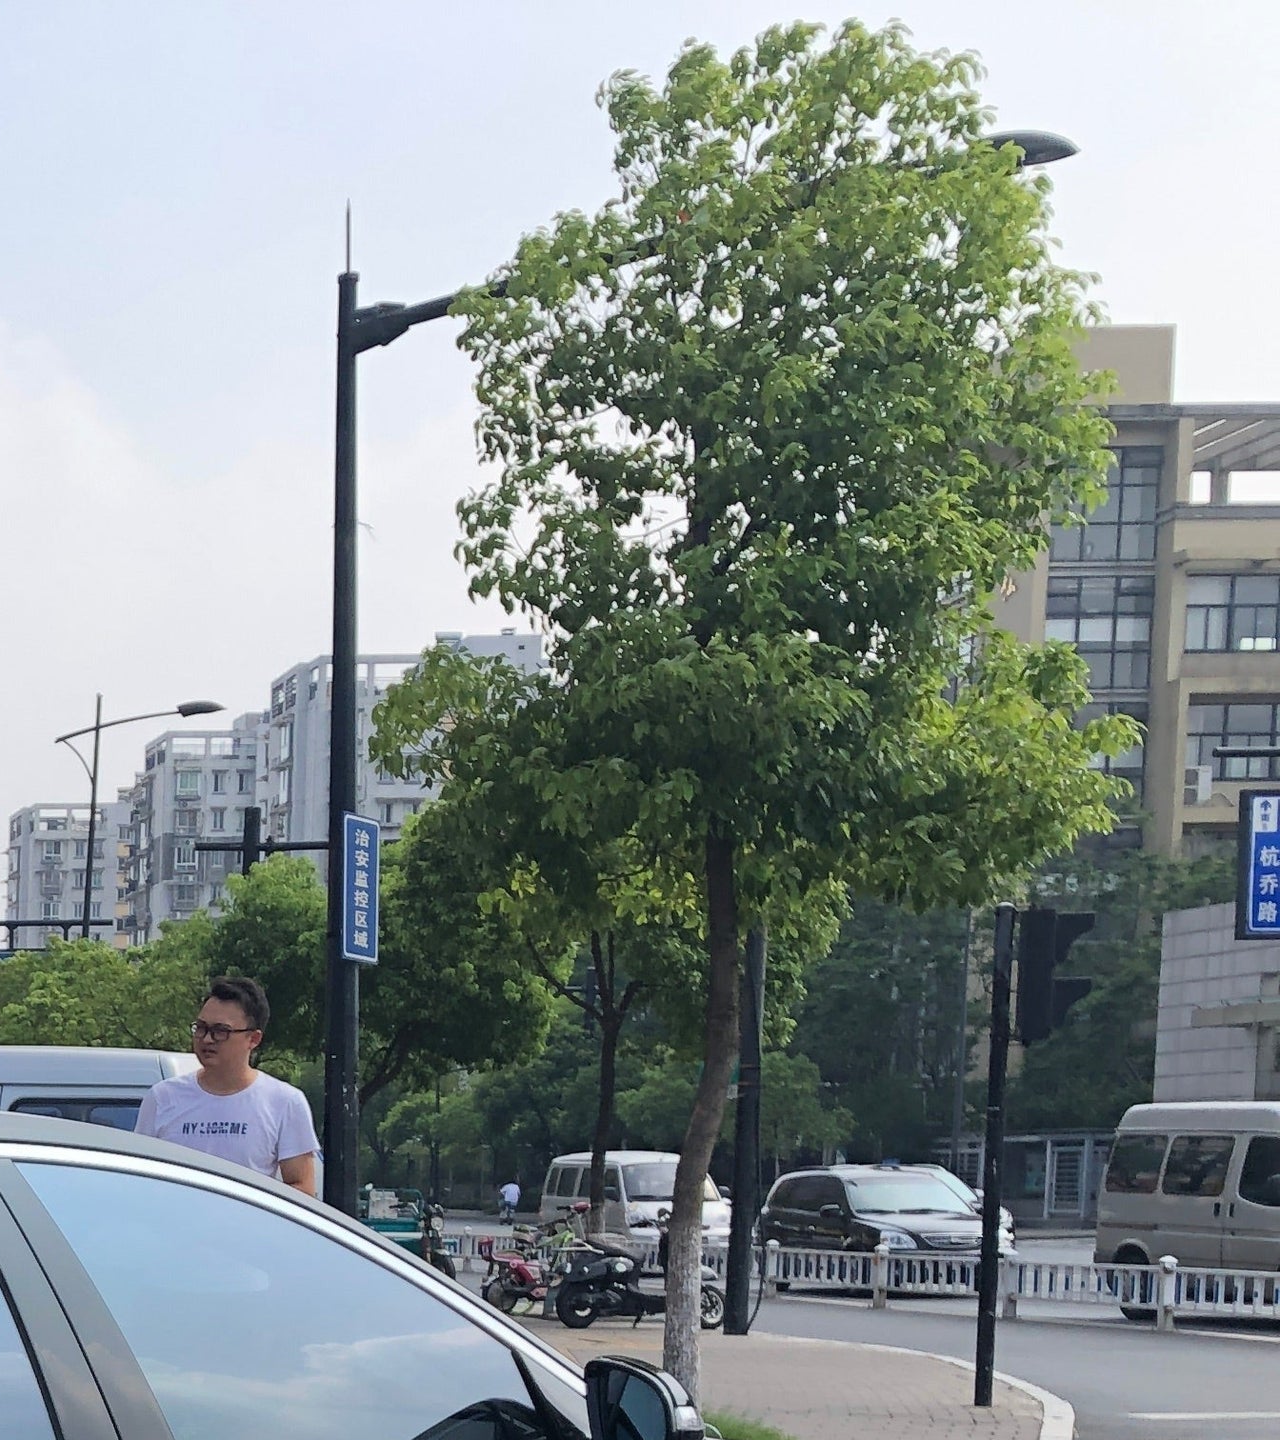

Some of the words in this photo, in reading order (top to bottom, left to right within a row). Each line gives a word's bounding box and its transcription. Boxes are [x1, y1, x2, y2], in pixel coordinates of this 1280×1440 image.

[353, 828, 371, 950] 治安监控区域
[1257, 845, 1280, 923] 杭乔路
